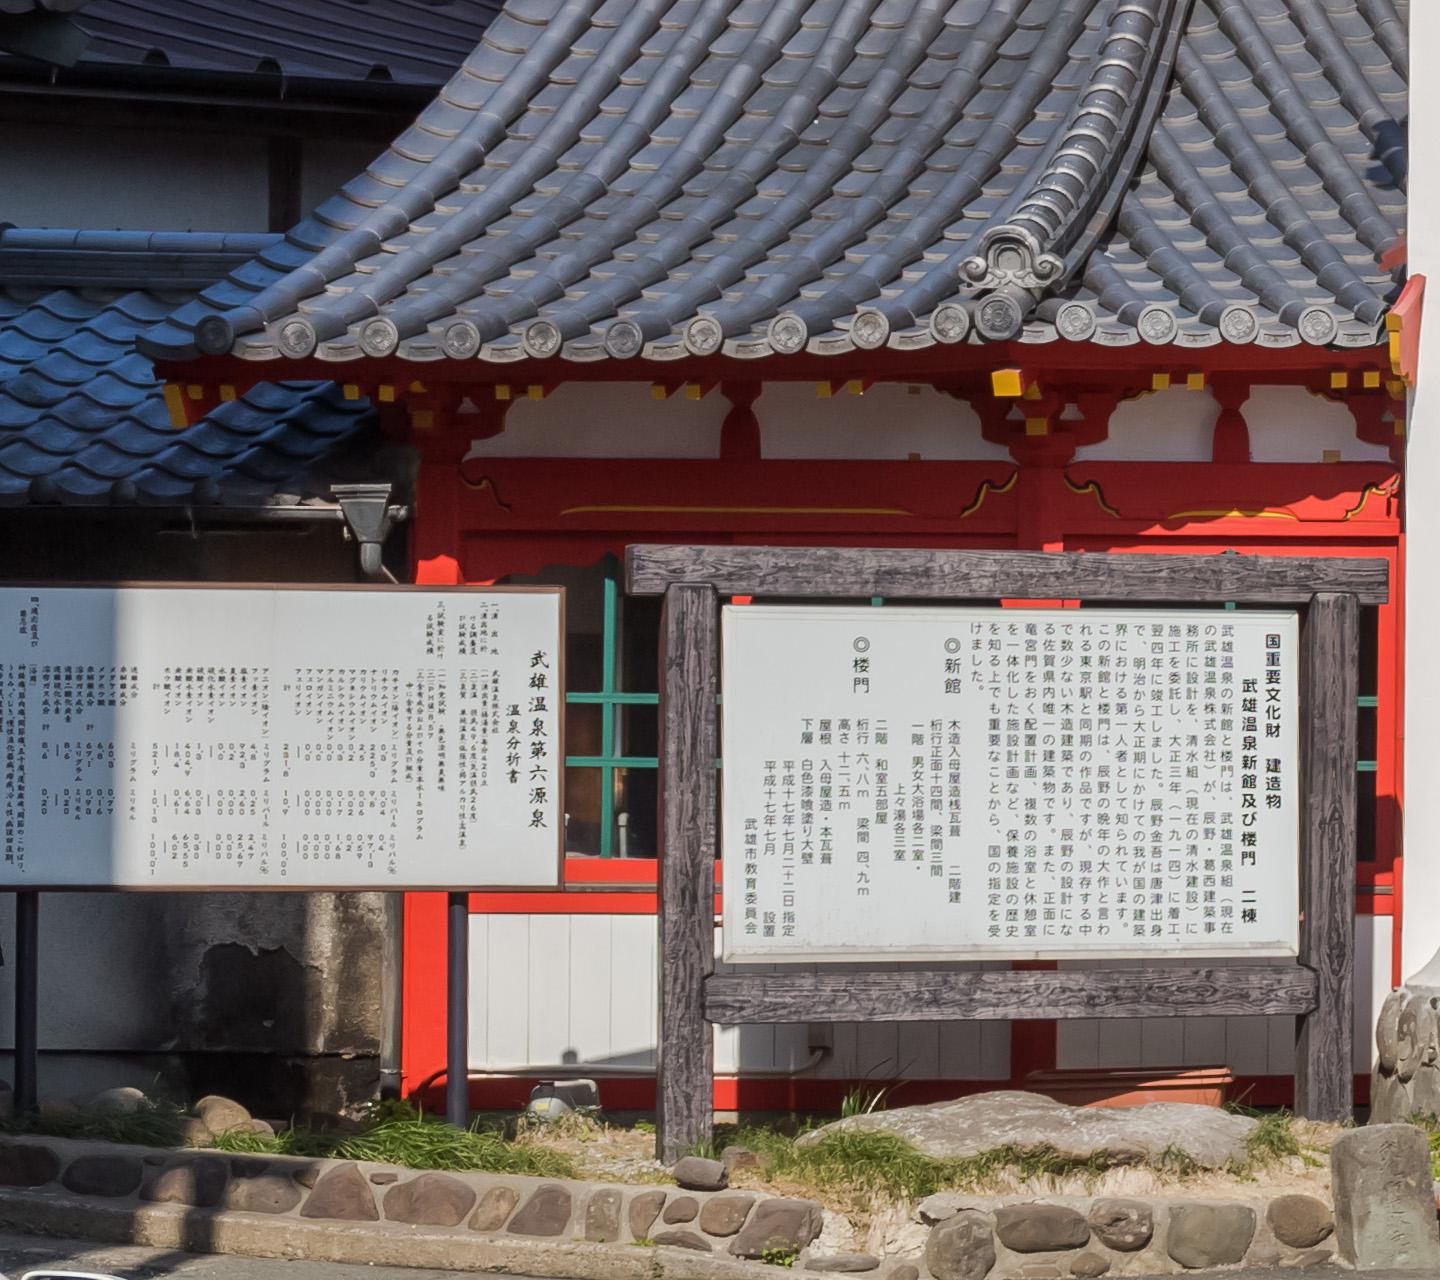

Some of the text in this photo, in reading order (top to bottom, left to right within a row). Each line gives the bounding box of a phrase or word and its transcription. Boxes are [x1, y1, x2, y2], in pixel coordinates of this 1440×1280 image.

[529, 651, 547, 827] 武雄温泉第六源泉
[820, 719, 831, 744] 屋根
[839, 719, 850, 744] 高さ
[857, 719, 868, 744] 桁行
[912, 725, 924, 745] 一階
[971, 623, 983, 690] けました。
[1266, 634, 1281, 808] 国重要文化財 建造物
[763, 761, 776, 937] 平成十七年七月 設置
[782, 761, 795, 936] 平成十七年七月二十二日 指定
[801, 719, 813, 864] 下層 白色漆喰塗り大壁
[857, 818, 869, 843] 梁間
[875, 720, 888, 824] 二階 和室五部屋
[894, 784, 905, 861] 上々湯各三室
[931, 719, 943, 877] 桁行正面十四間、梁間三間
[988, 623, 1000, 937] を知る上でも重要なことから、国の指定を受
[1006, 624, 1019, 937] を一体化した施設計画など、保養施設の歴史
[1024, 623, 1037, 936] 竜宮門をおく配置計画、複数の浴室と休憩室
[1043, 624, 1055, 935] る佐賀県内唯一の建築物です。また、正面に
[1061, 624, 1073, 936] で数少ない木造建築であり、辰野の設計にな
[1080, 624, 1092, 936] れる東京駅と同期の作品ですが、現存する中
[1098, 625, 1110, 935] この新館と楼門は、辰野の晩年の大作と言わ
[1116, 624, 1128, 927] 界における第一人者として知られています。
[1133, 625, 1146, 936] で、明治から大正期にかけての我が国の建築
[1151, 624, 1163, 936] 翌四年に竣工しました。辰野金吾は唐津出身
[1169, 624, 1181, 942] 施工を委託し、大正三年（一九一四）に着工、
[1186, 624, 1198, 935] 務所に設計を、清水組（現在の清水建設）に
[1204, 624, 1216, 935] の武雄温泉株式会社）が、辰野・葛西建築事
[1221, 624, 1233, 935] 武雄温泉の新館と楼門は、武雄温泉組（現在
[1242, 679, 1257, 923] 武雄温泉新館及び楼門 二棟
[745, 818, 757, 934] 武雄市教育委員会
[949, 866, 960, 903] 二階建
